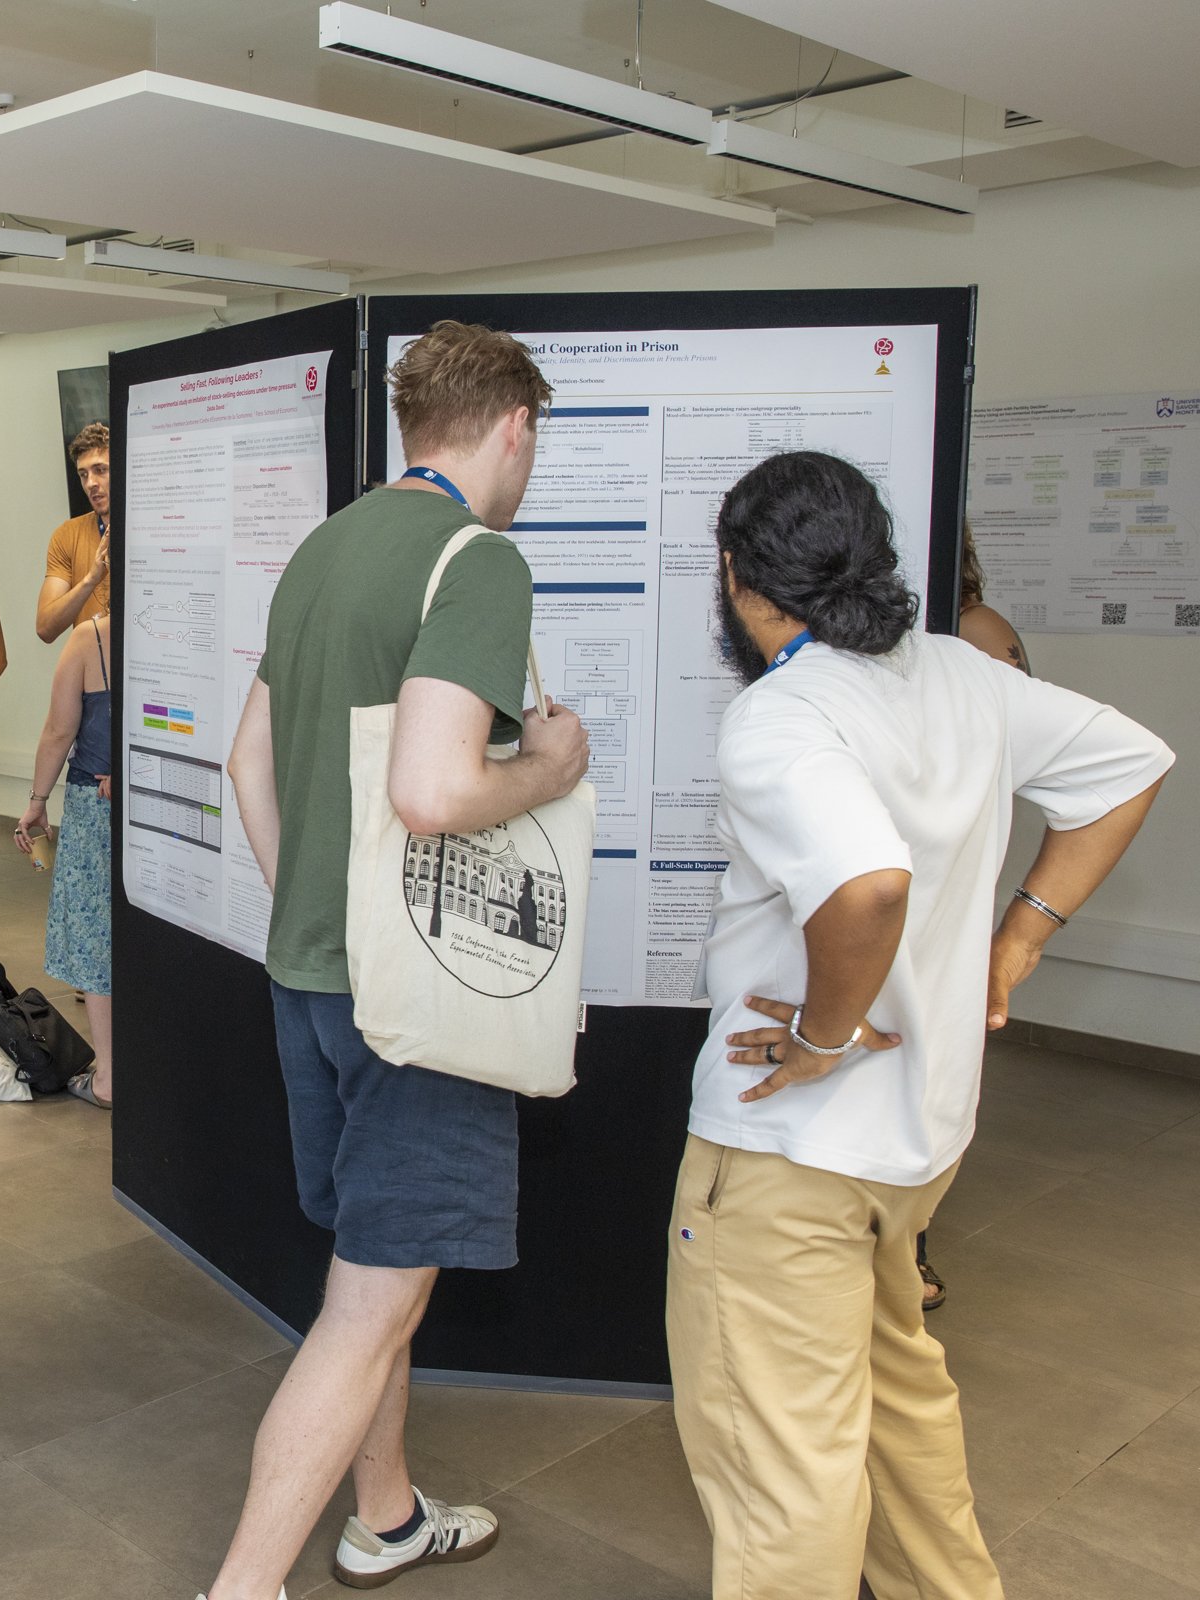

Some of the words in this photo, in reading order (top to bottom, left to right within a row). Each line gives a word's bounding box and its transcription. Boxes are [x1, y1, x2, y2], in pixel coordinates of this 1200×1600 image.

[531, 344, 545, 354] nd
[550, 342, 622, 356] Cooperation
[626, 342, 637, 352] in
[641, 342, 679, 352] Prison
[180, 380, 196, 392] Selling
[196, 378, 206, 388] Fast,
[208, 374, 234, 386] Following
[235, 372, 258, 382] Leaders
[278, 383, 297, 392] pressure
[510, 953, 530, 965] French
